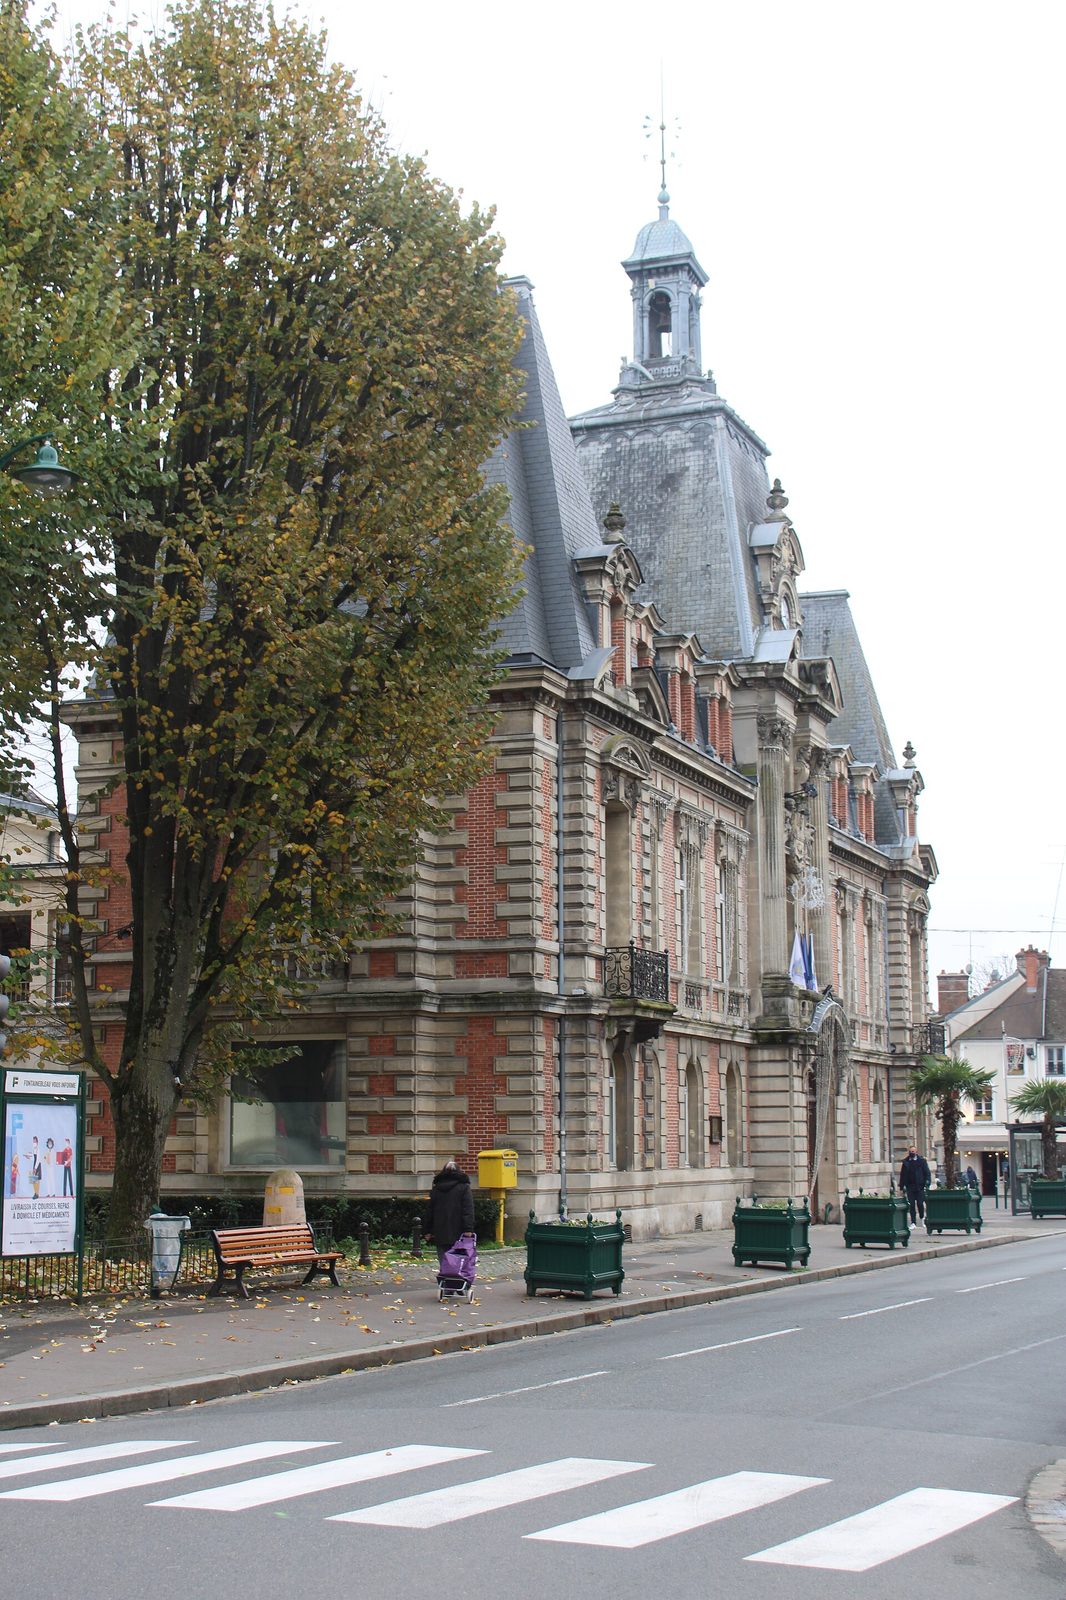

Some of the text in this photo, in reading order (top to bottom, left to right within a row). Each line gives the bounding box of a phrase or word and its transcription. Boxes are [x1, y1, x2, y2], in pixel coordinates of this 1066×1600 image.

[23, 1079, 51, 1088] FONTAINEBLEAU
[11, 1113, 24, 1136] F
[11, 1203, 31, 1211] LIVRAISON
[57, 1202, 70, 1210] REPAS
[36, 1211, 41, 1219] ET
